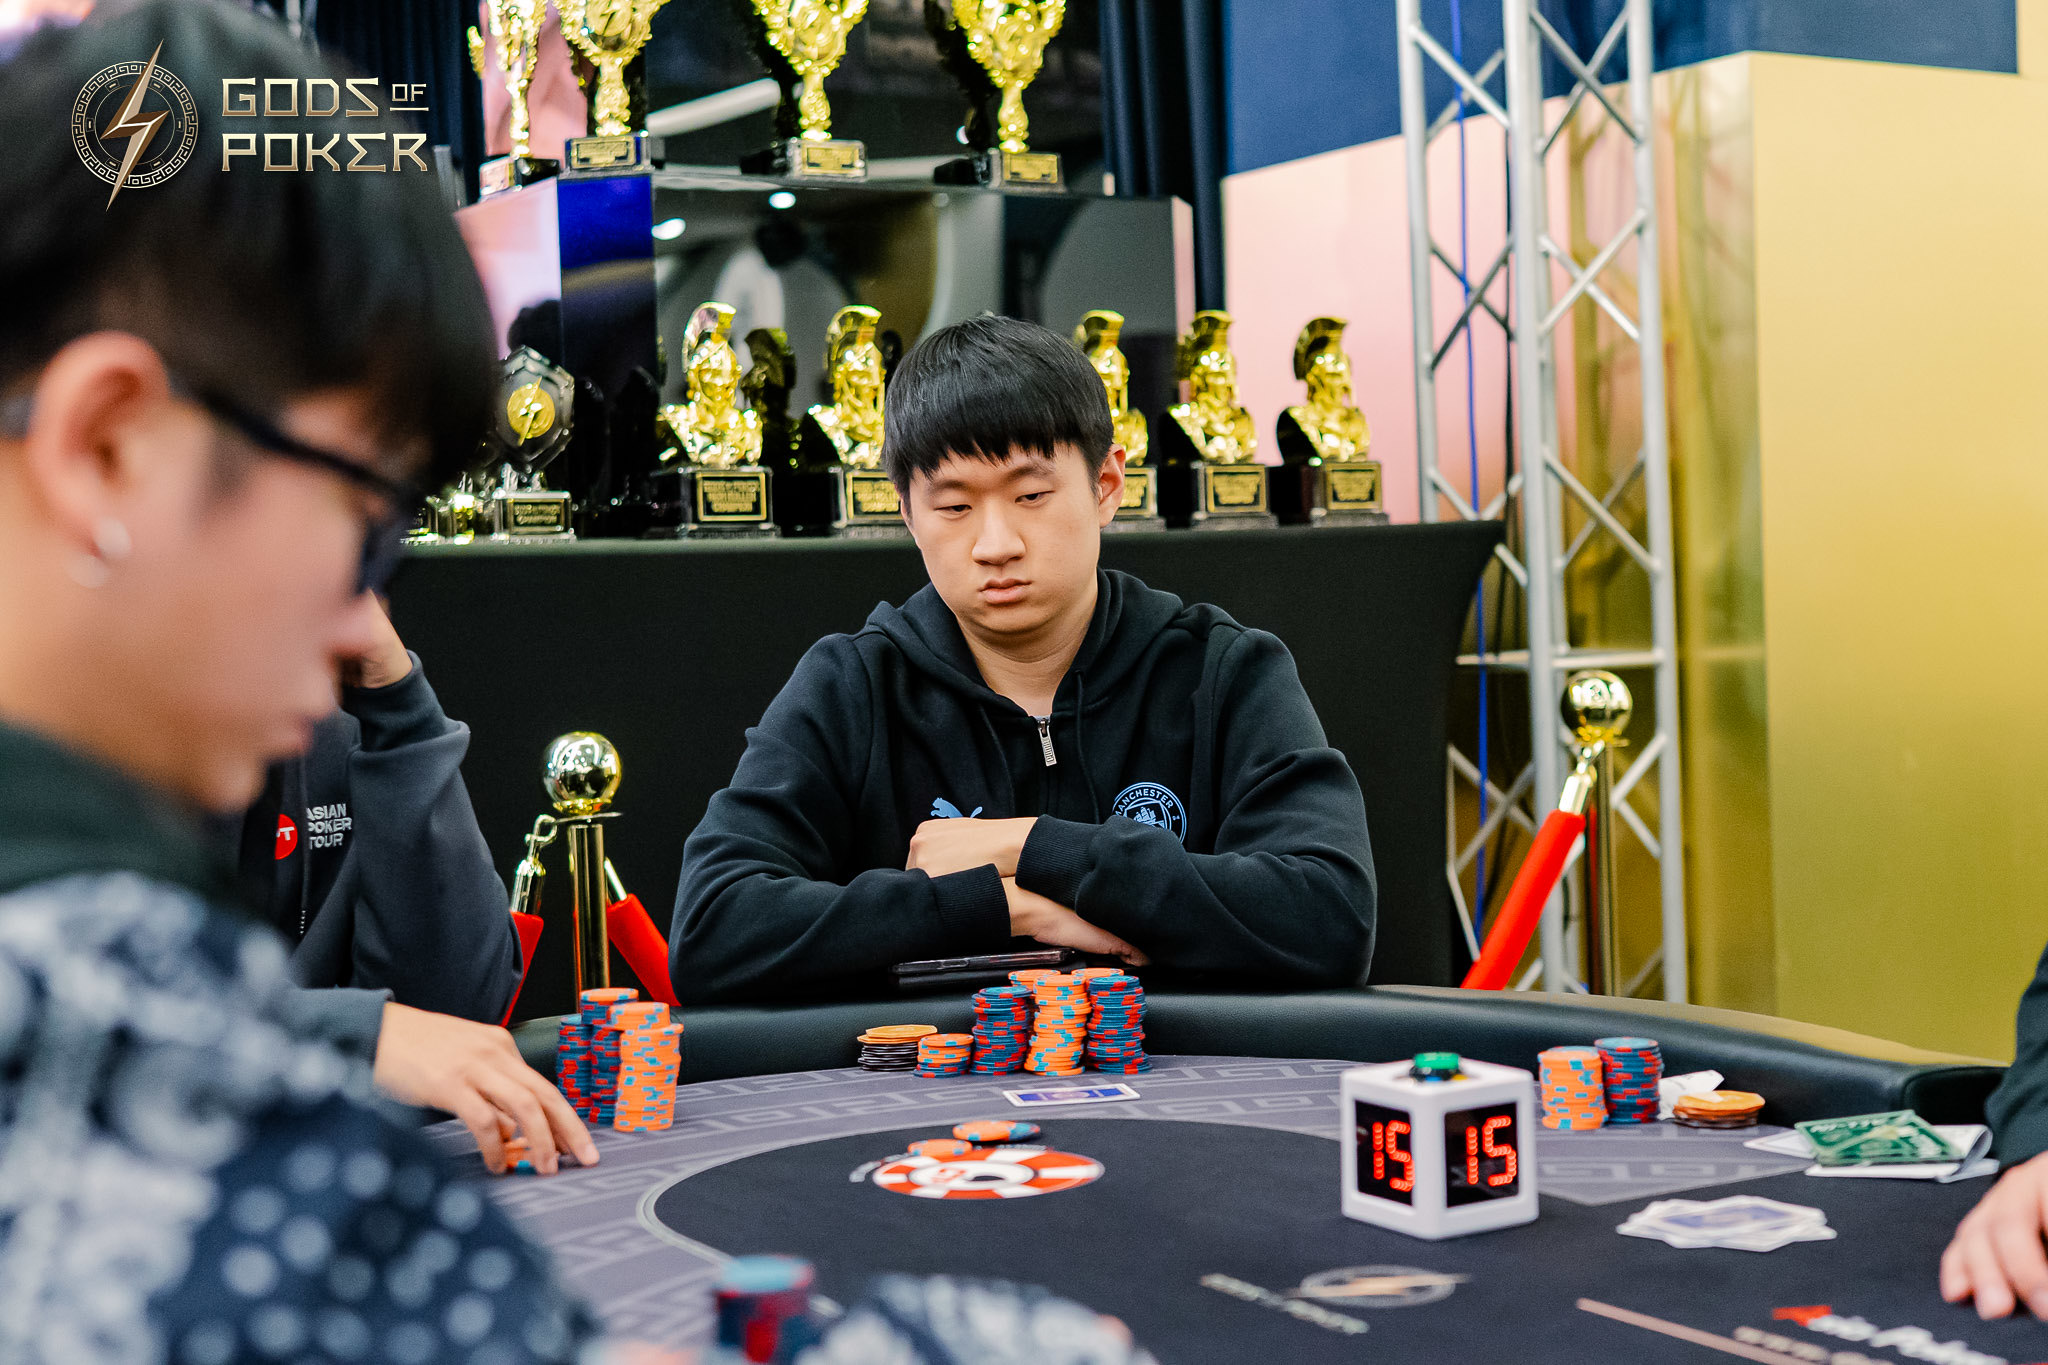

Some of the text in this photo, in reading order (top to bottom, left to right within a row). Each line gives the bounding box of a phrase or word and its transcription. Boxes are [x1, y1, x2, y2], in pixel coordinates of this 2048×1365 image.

[306, 803, 346, 821] ASIAN
[275, 826, 295, 841] T
[309, 833, 343, 850] TOUR
[1372, 1120, 1415, 1192] 15
[1466, 1115, 1517, 1186] 15
